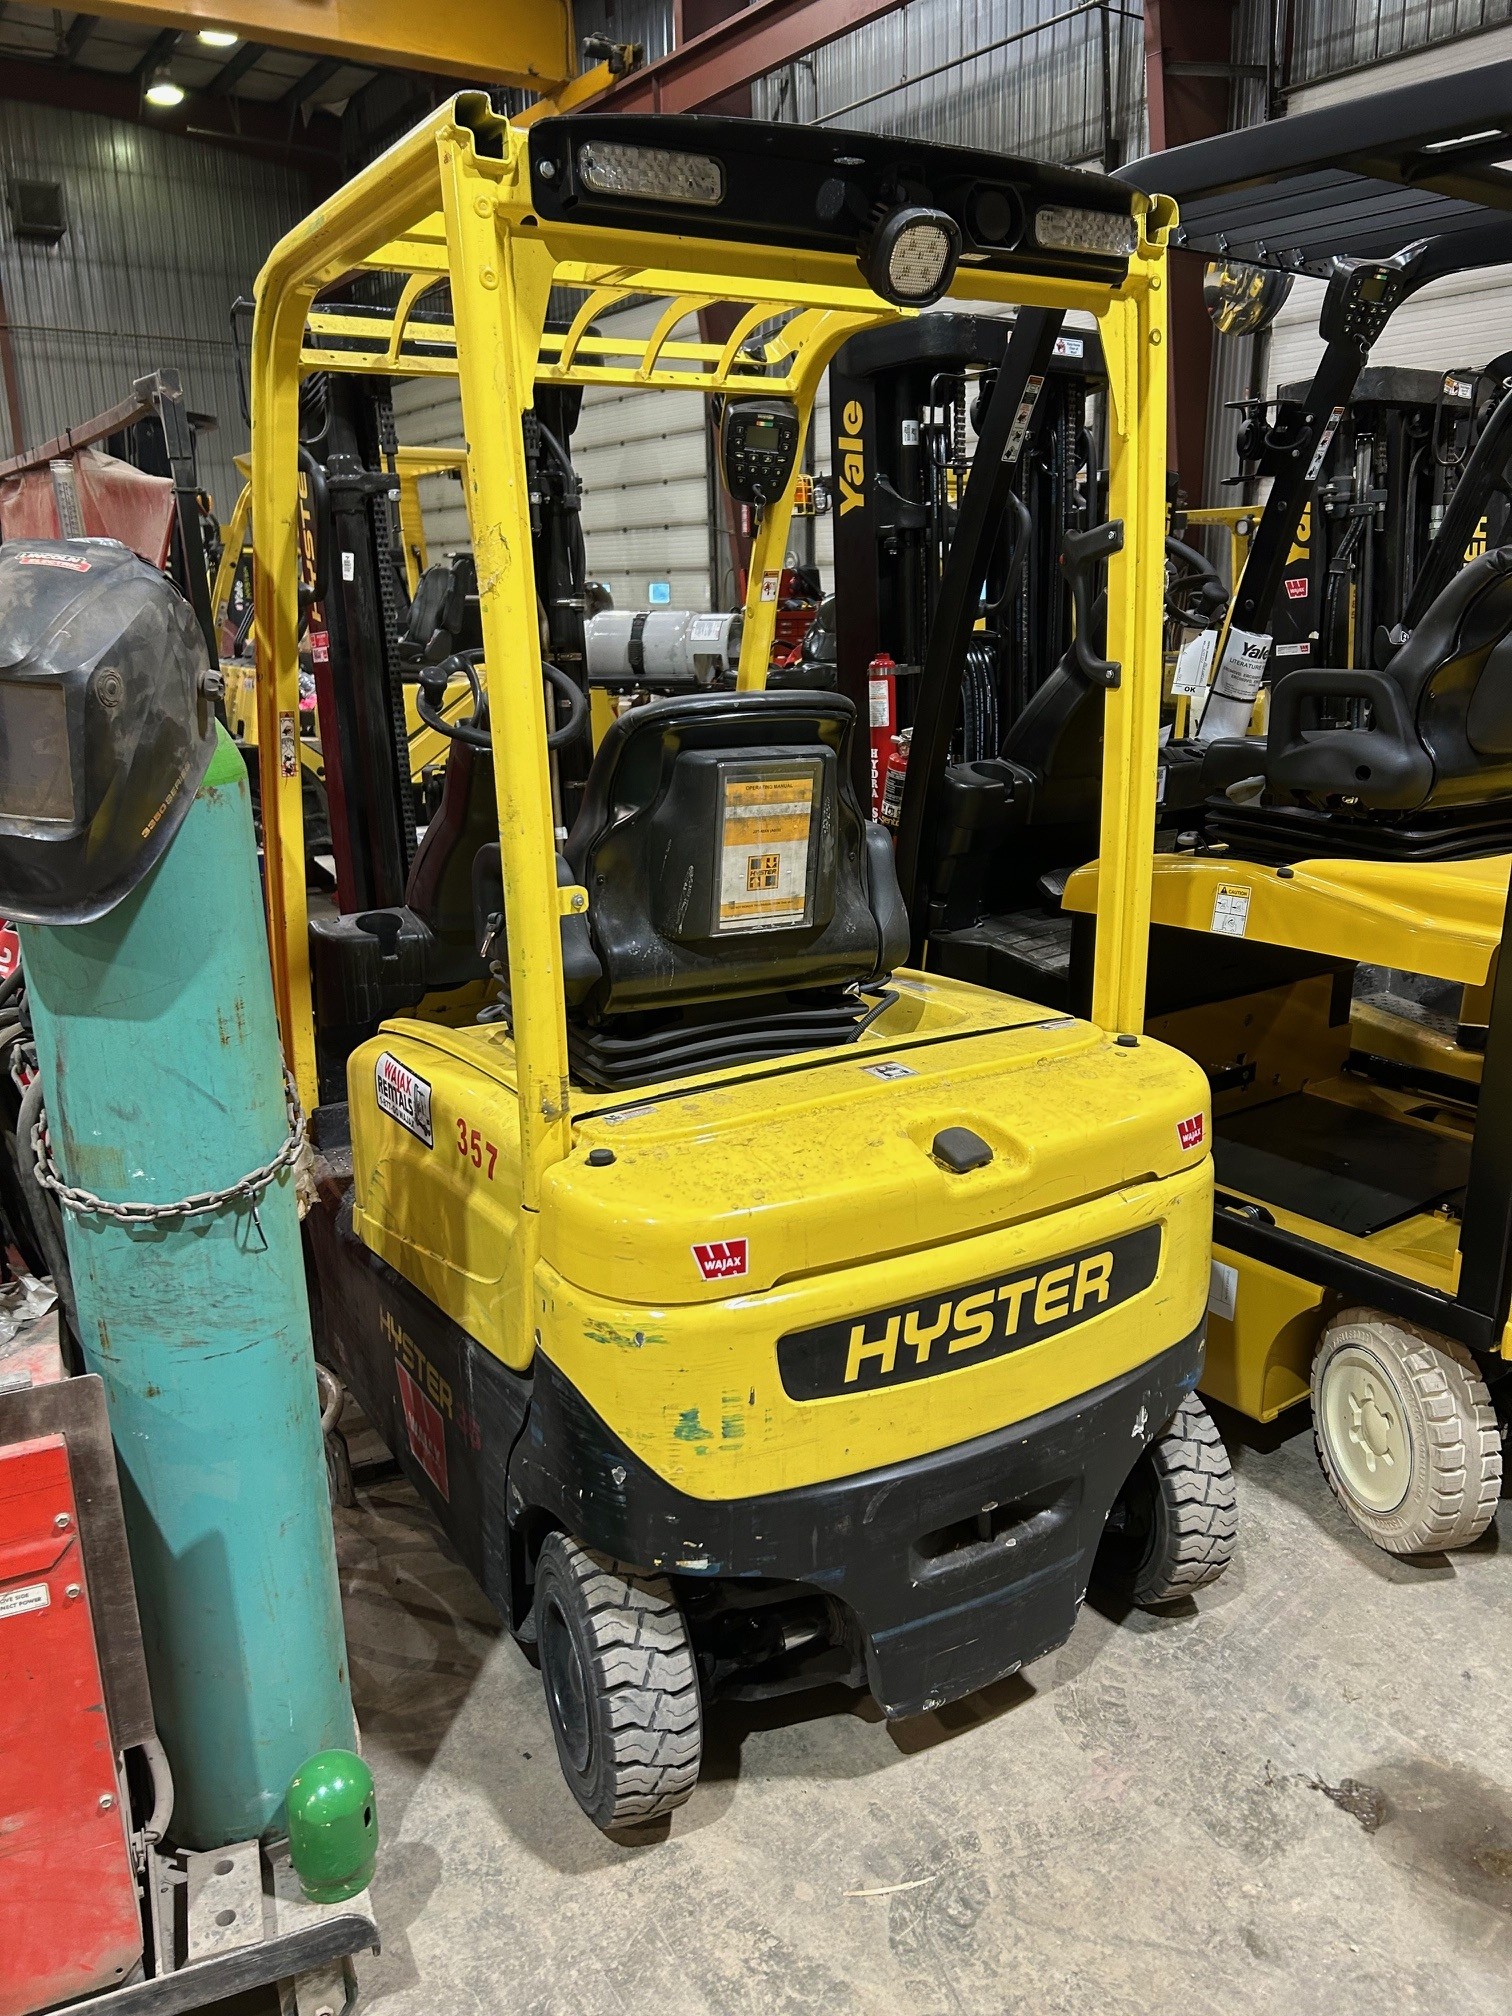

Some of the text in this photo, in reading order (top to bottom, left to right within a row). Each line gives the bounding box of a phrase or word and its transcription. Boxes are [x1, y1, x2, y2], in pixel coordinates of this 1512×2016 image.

[838, 399, 865, 517] Yale
[1229, 656, 1263, 671] LITERATURE
[1242, 641, 1270, 660] Yale
[870, 748, 879, 798] HYDRA
[750, 867, 777, 877] HYSTER
[377, 1074, 414, 1117] RENTALS
[384, 1060, 413, 1097] WAJAX
[456, 1117, 498, 1181] 357
[1182, 1127, 1201, 1143] WAJAX
[704, 1256, 742, 1271] WAJAX
[844, 1251, 1114, 1383] HYSTER
[379, 1303, 453, 1420] HYSTER
[19, 1597, 42, 1606] POWER
